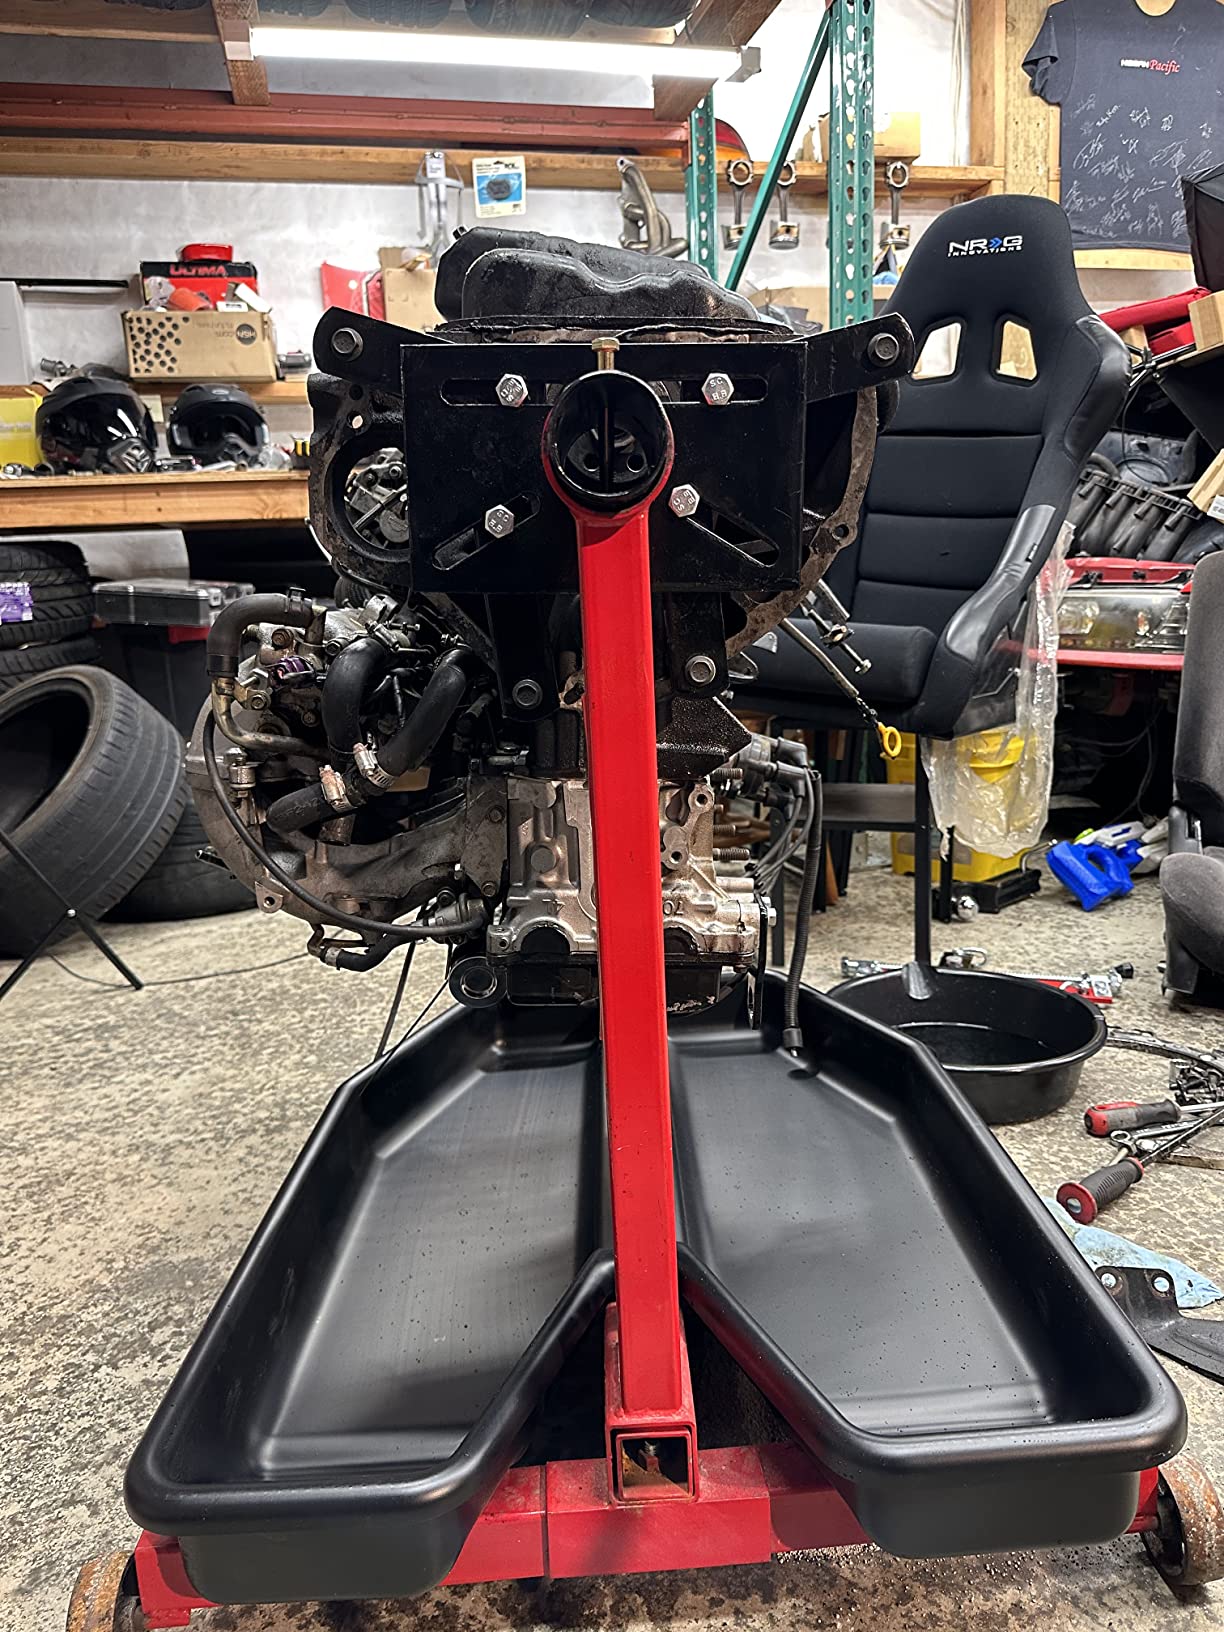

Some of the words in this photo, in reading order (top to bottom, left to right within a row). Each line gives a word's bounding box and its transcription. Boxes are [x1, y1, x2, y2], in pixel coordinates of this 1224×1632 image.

[1149, 59, 1181, 75] Pacific
[947, 245, 1022, 257] INNOVATIONS
[169, 263, 227, 276] ULTIMA
